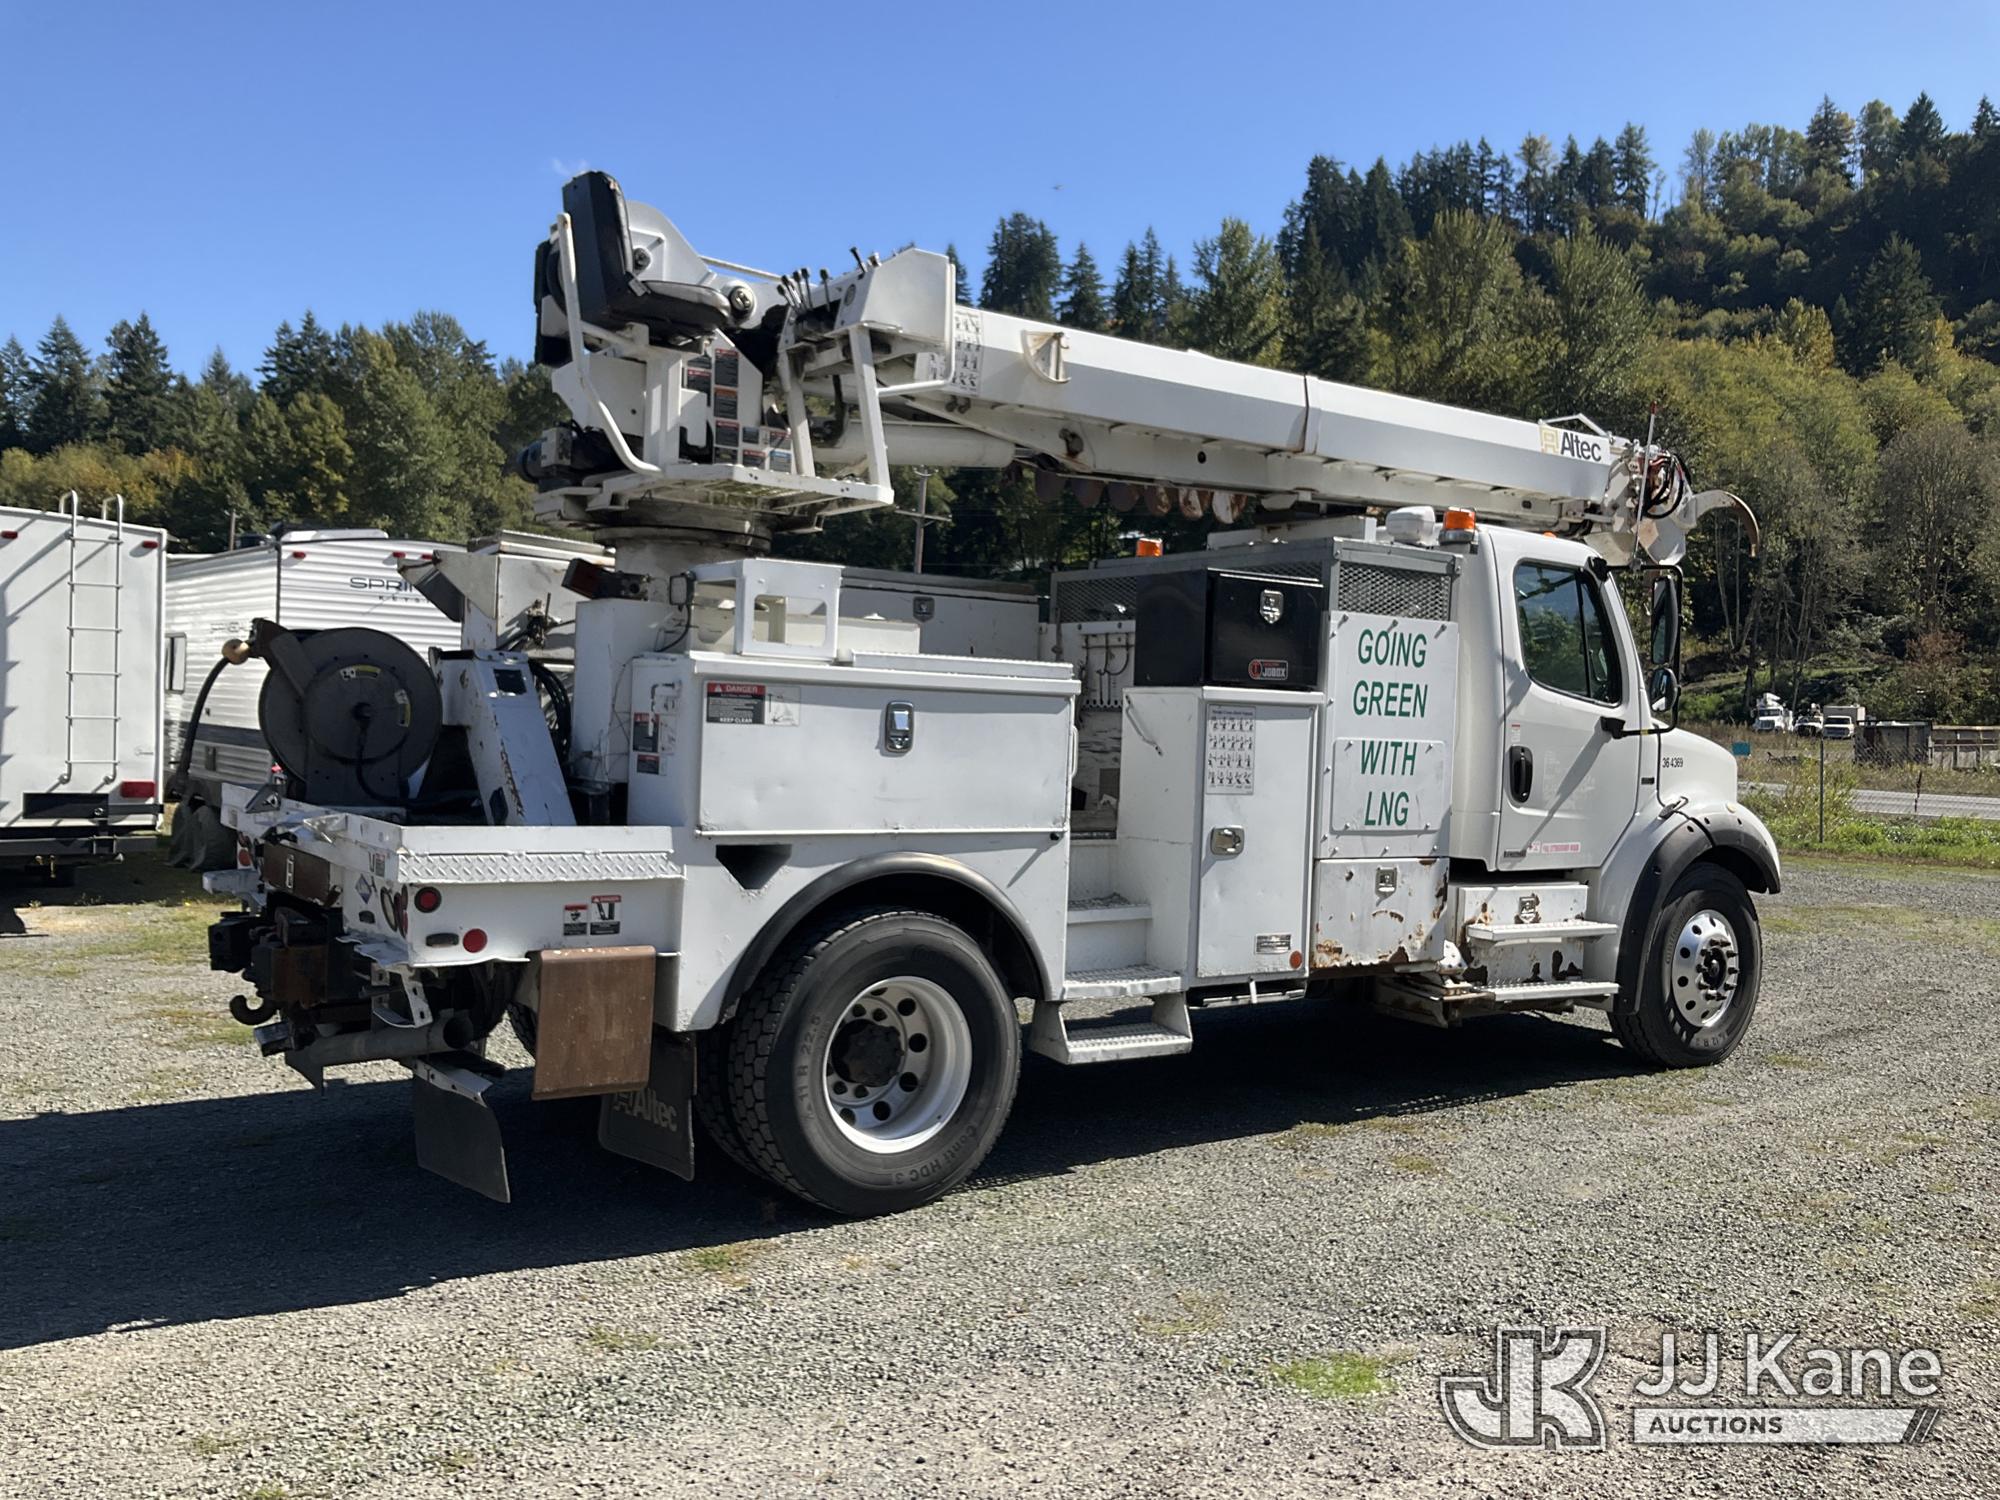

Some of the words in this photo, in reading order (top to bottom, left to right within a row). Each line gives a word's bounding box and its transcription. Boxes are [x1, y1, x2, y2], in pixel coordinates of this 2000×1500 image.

[1560, 432, 1602, 461] Altec
[1357, 628, 1428, 668] GOING
[726, 684, 758, 694] DANGER
[1352, 679, 1429, 718] GREEN
[1360, 740, 1418, 776] WITH
[1363, 791, 1410, 827] LNG
